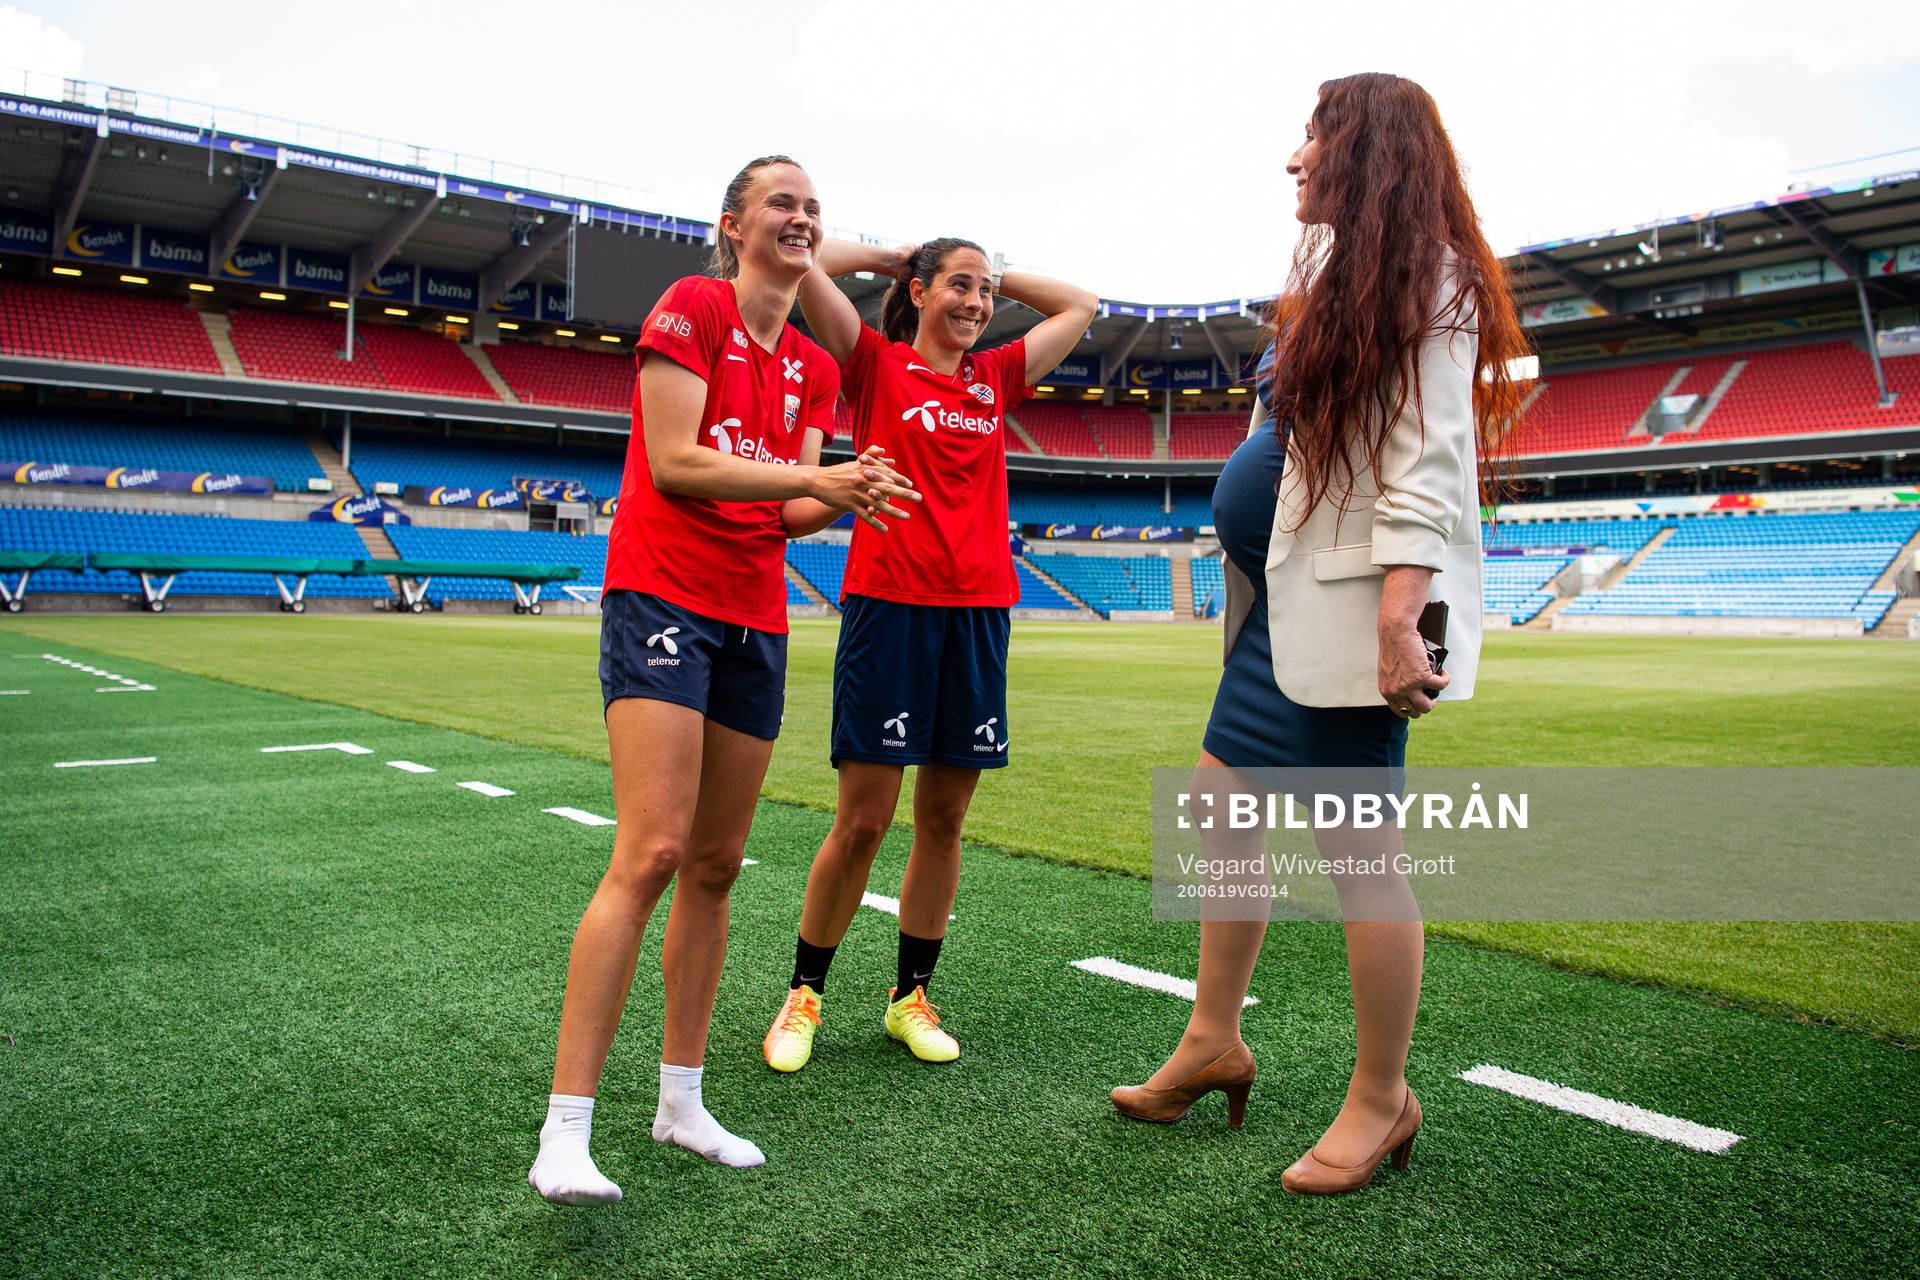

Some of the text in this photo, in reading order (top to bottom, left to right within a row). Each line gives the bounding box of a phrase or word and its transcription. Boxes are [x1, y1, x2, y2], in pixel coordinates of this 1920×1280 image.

[19, 103, 38, 114] OG
[40, 106, 98, 125] AKTIVITET
[108, 118, 130, 131] GIR
[0, 223, 48, 242] ama
[150, 240, 204, 263] bama
[295, 260, 345, 282] bama
[427, 279, 472, 299] bama
[656, 314, 692, 337] DNB
[1174, 364, 1208, 381] bama
[938, 408, 999, 435] telenor
[30, 463, 71, 483] Bendit
[120, 469, 160, 488] Bendit
[205, 475, 243, 493] Bendit
[647, 657, 681, 667] telenor
[882, 738, 907, 748] telenor
[973, 744, 995, 753] telenor
